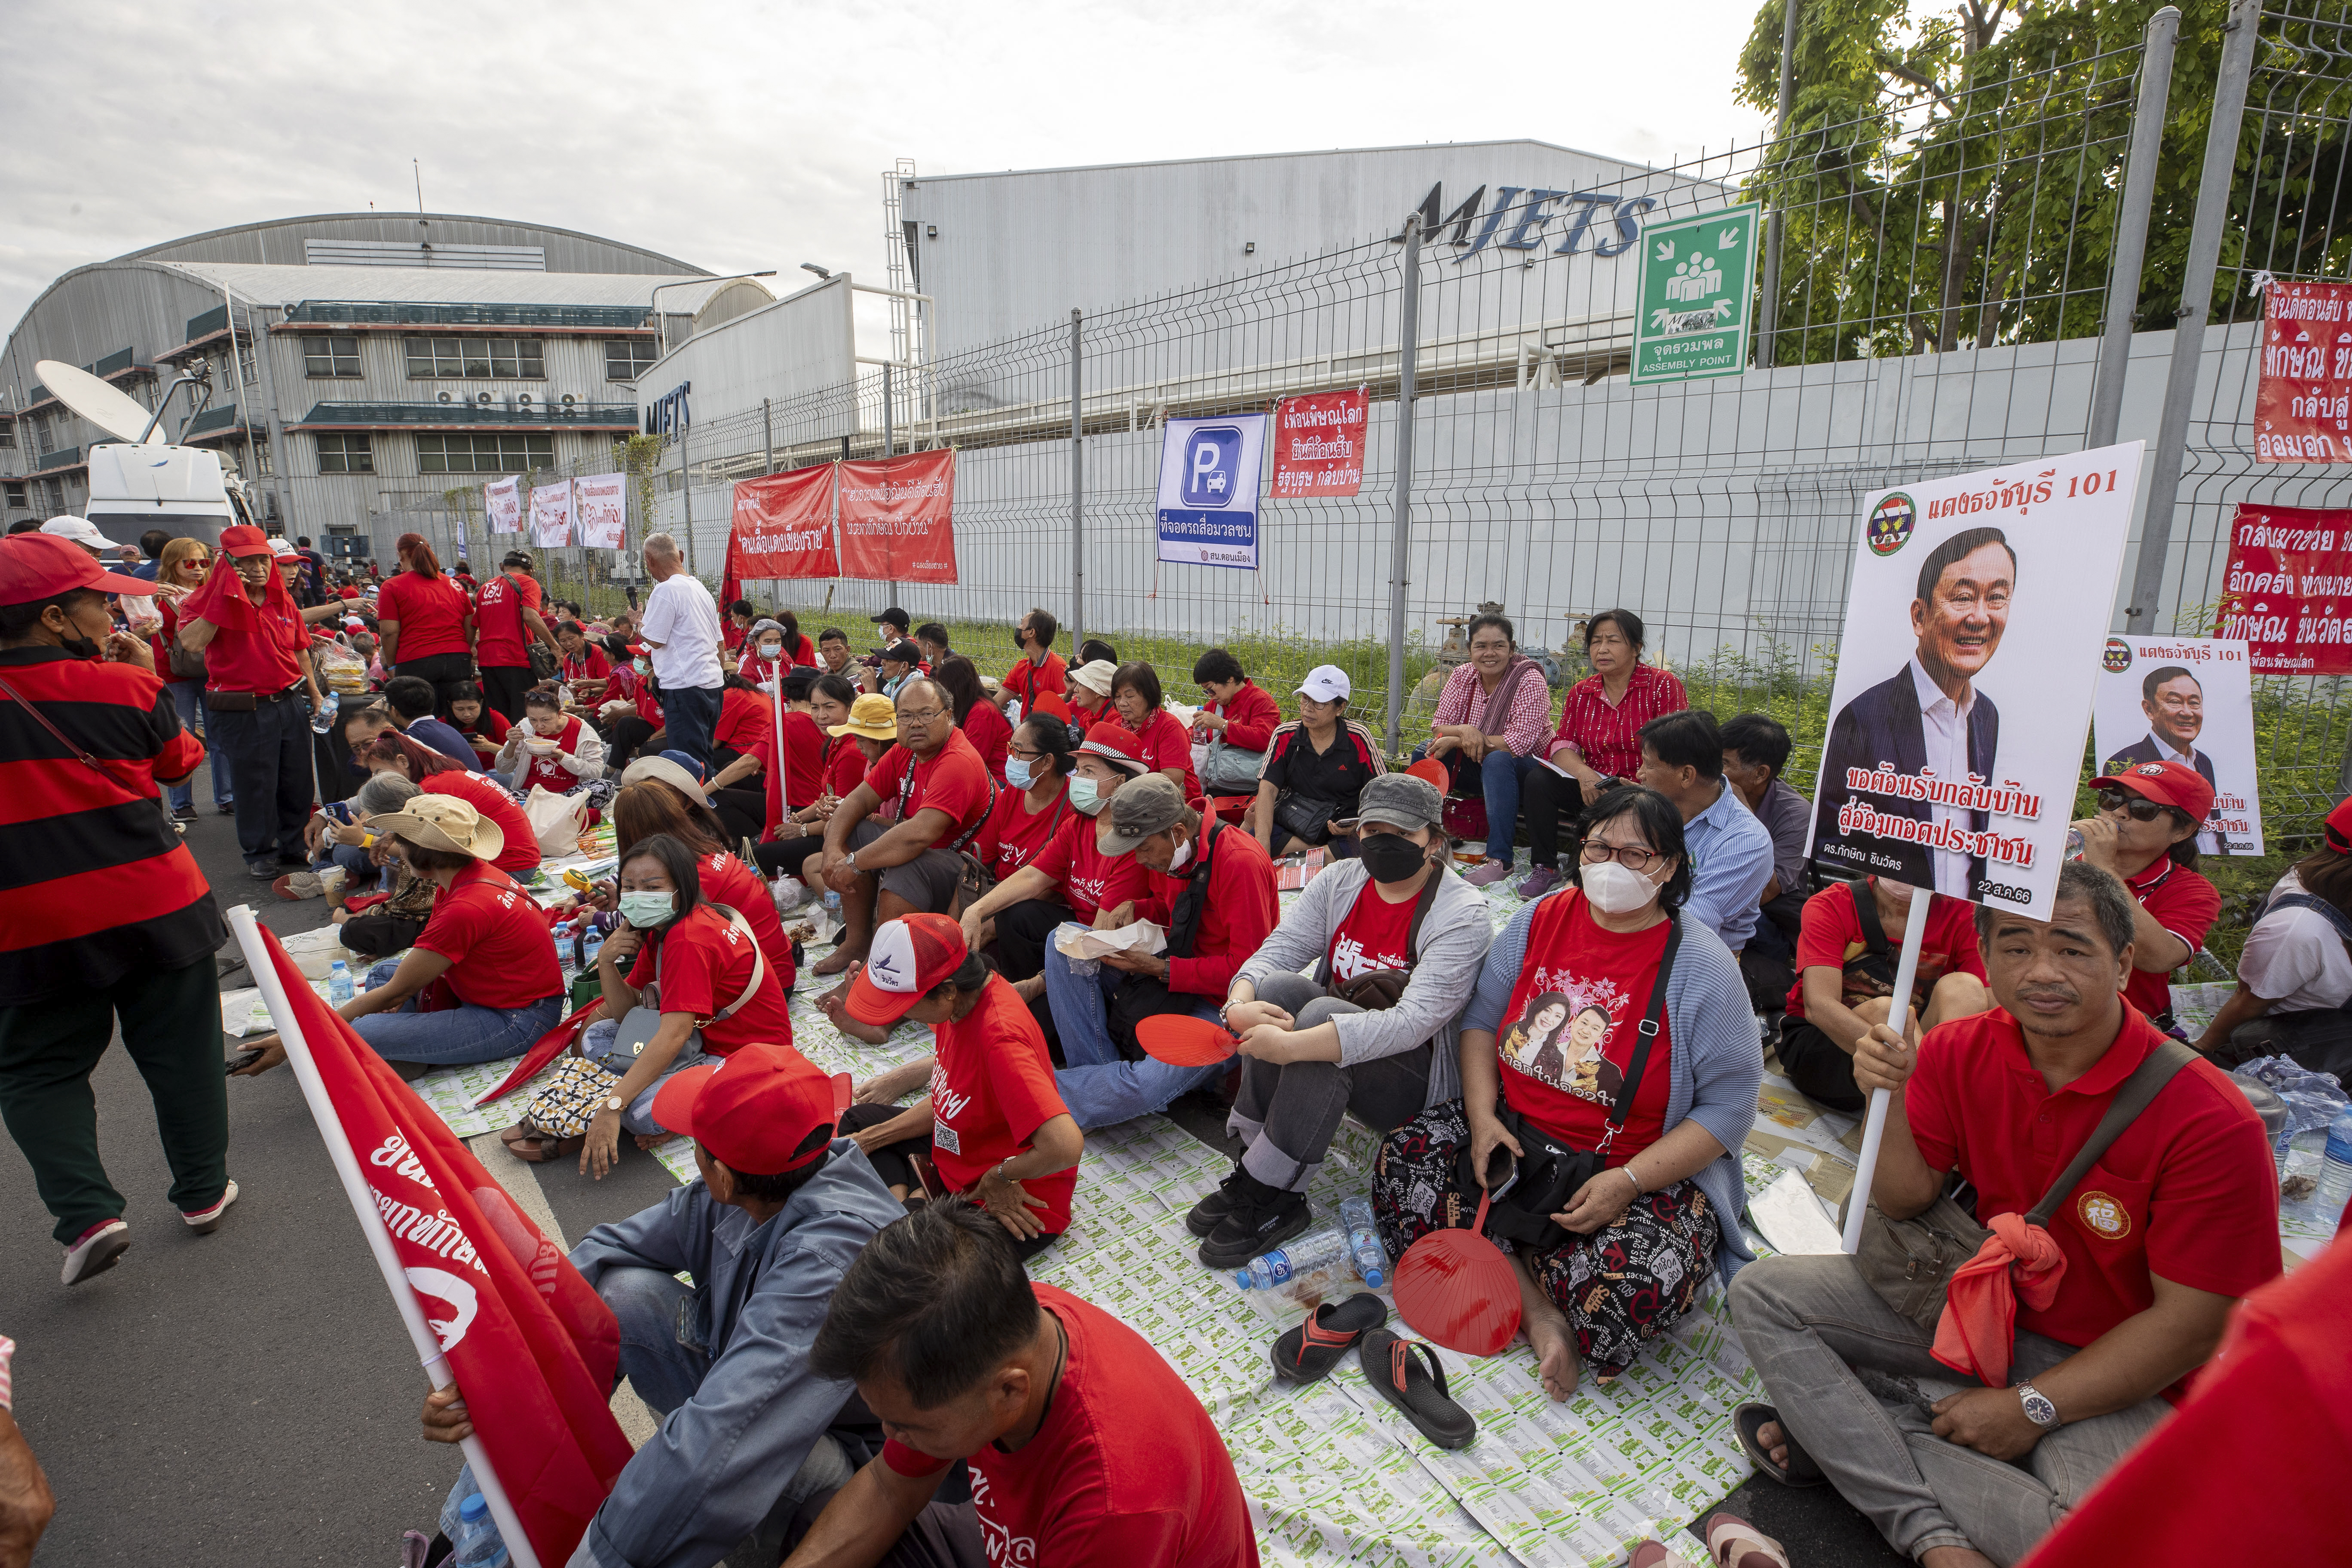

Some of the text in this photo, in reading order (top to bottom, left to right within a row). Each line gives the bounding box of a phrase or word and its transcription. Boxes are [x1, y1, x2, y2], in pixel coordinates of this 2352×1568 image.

[1642, 355, 1732, 373] ASSEMBLY POINT
[1654, 338, 1724, 361] จุดรวมพล
[2266, 330, 2325, 379] ทักษิณ
[1284, 400, 1362, 432] เพื่อนพิษณุโลก
[2292, 386, 2349, 430] กลับสู่
[1292, 435, 1353, 461] ยินดีต้อนรับ
[2258, 421, 2335, 457] อ้อมอก
[1191, 443, 1220, 493] P
[1317, 462, 1360, 487] กลับบ้าน
[1929, 469, 2118, 520] แดงธวัชบุรี 101
[1160, 511, 1251, 538] ที่จอดรถสื่อมวลชน
[2238, 515, 2334, 551] กลับมาช่วย
[1210, 550, 1250, 563] สน.ดอนเมือง
[2230, 554, 2294, 594] อีกครั้ง
[2139, 643, 2242, 665] แดงธวัชบุรี 101
[1847, 762, 2041, 819] ขอต้อนรับกลับบ้าน
[1839, 796, 2034, 867] สู่อ้อมกอดประชาชน
[1824, 842, 1902, 871] ดร.ทักษิณ ชินวัตร
[2088, 1199, 2119, 1232] 福
